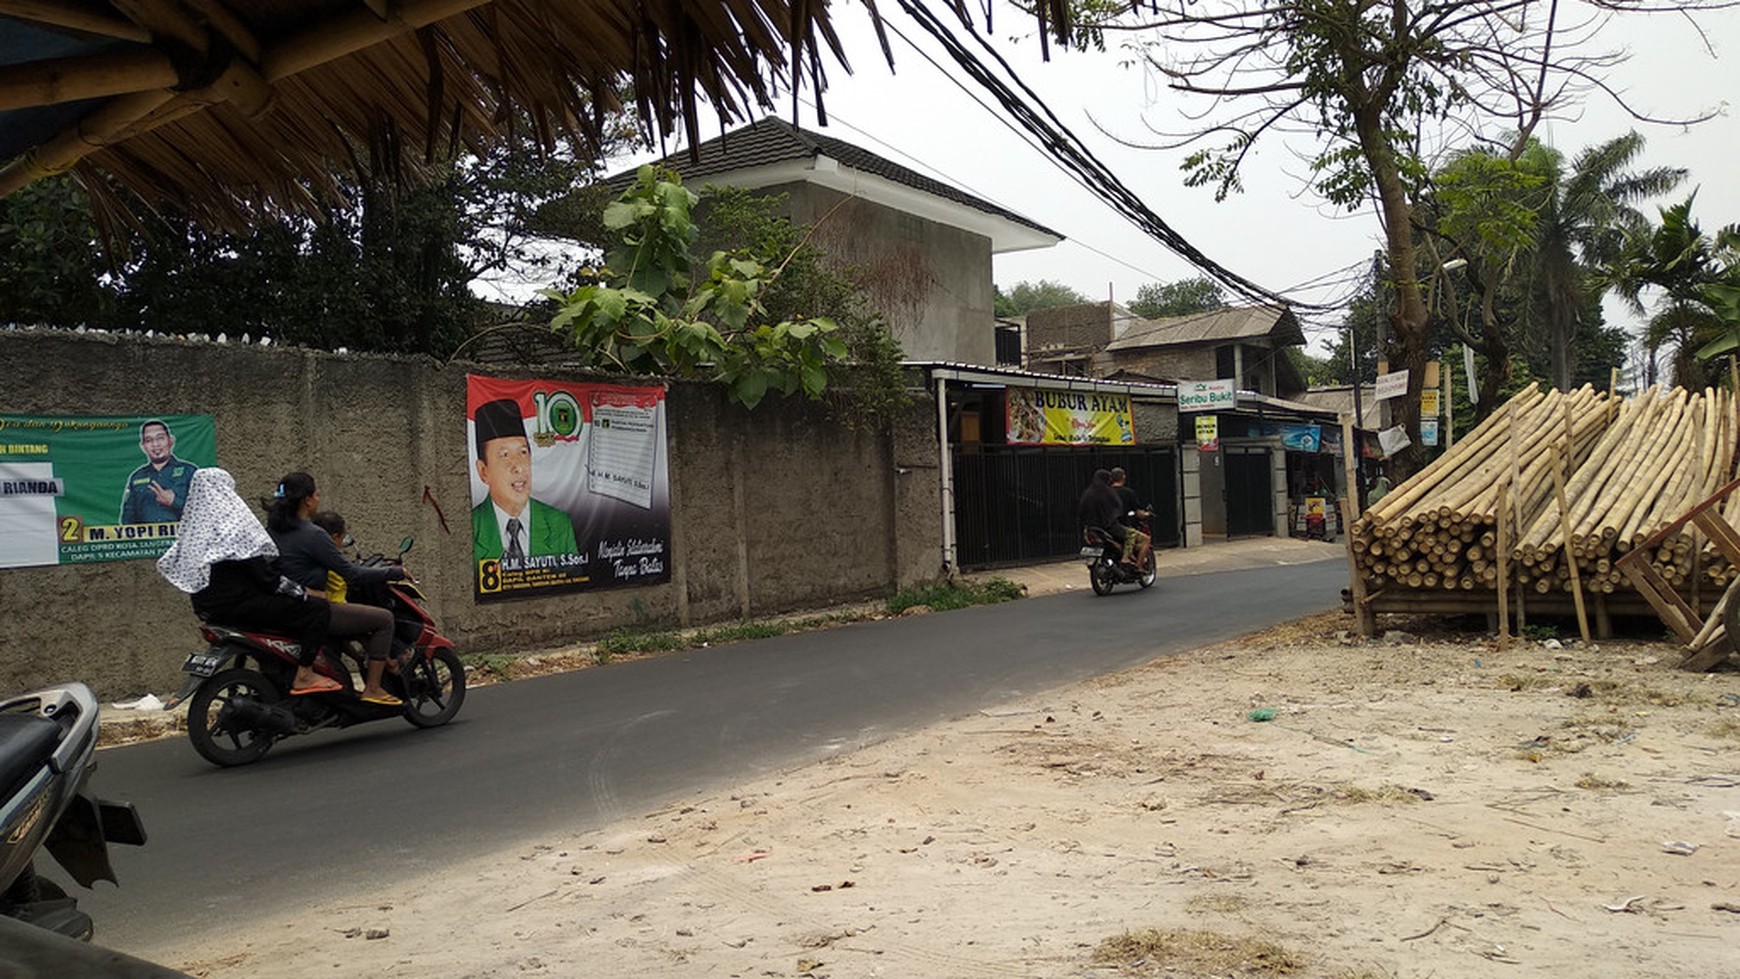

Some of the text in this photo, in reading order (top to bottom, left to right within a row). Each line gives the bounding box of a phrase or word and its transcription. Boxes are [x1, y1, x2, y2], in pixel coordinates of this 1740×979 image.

[1035, 391, 1128, 414] BUBUR AYAM
[1180, 391, 1233, 405] Seribu Bukit
[8, 444, 48, 454] BINTANG
[3, 481, 58, 494] RIANDA
[62, 518, 79, 541] 2
[89, 528, 110, 540] M.
[115, 525, 153, 539] YOPI
[61, 543, 89, 553] CALEG
[90, 542, 115, 551] DPRD
[116, 541, 138, 550] KOTA
[71, 552, 97, 561] DAPIL
[105, 548, 155, 558] KECAMATAN
[482, 560, 500, 590] 8
